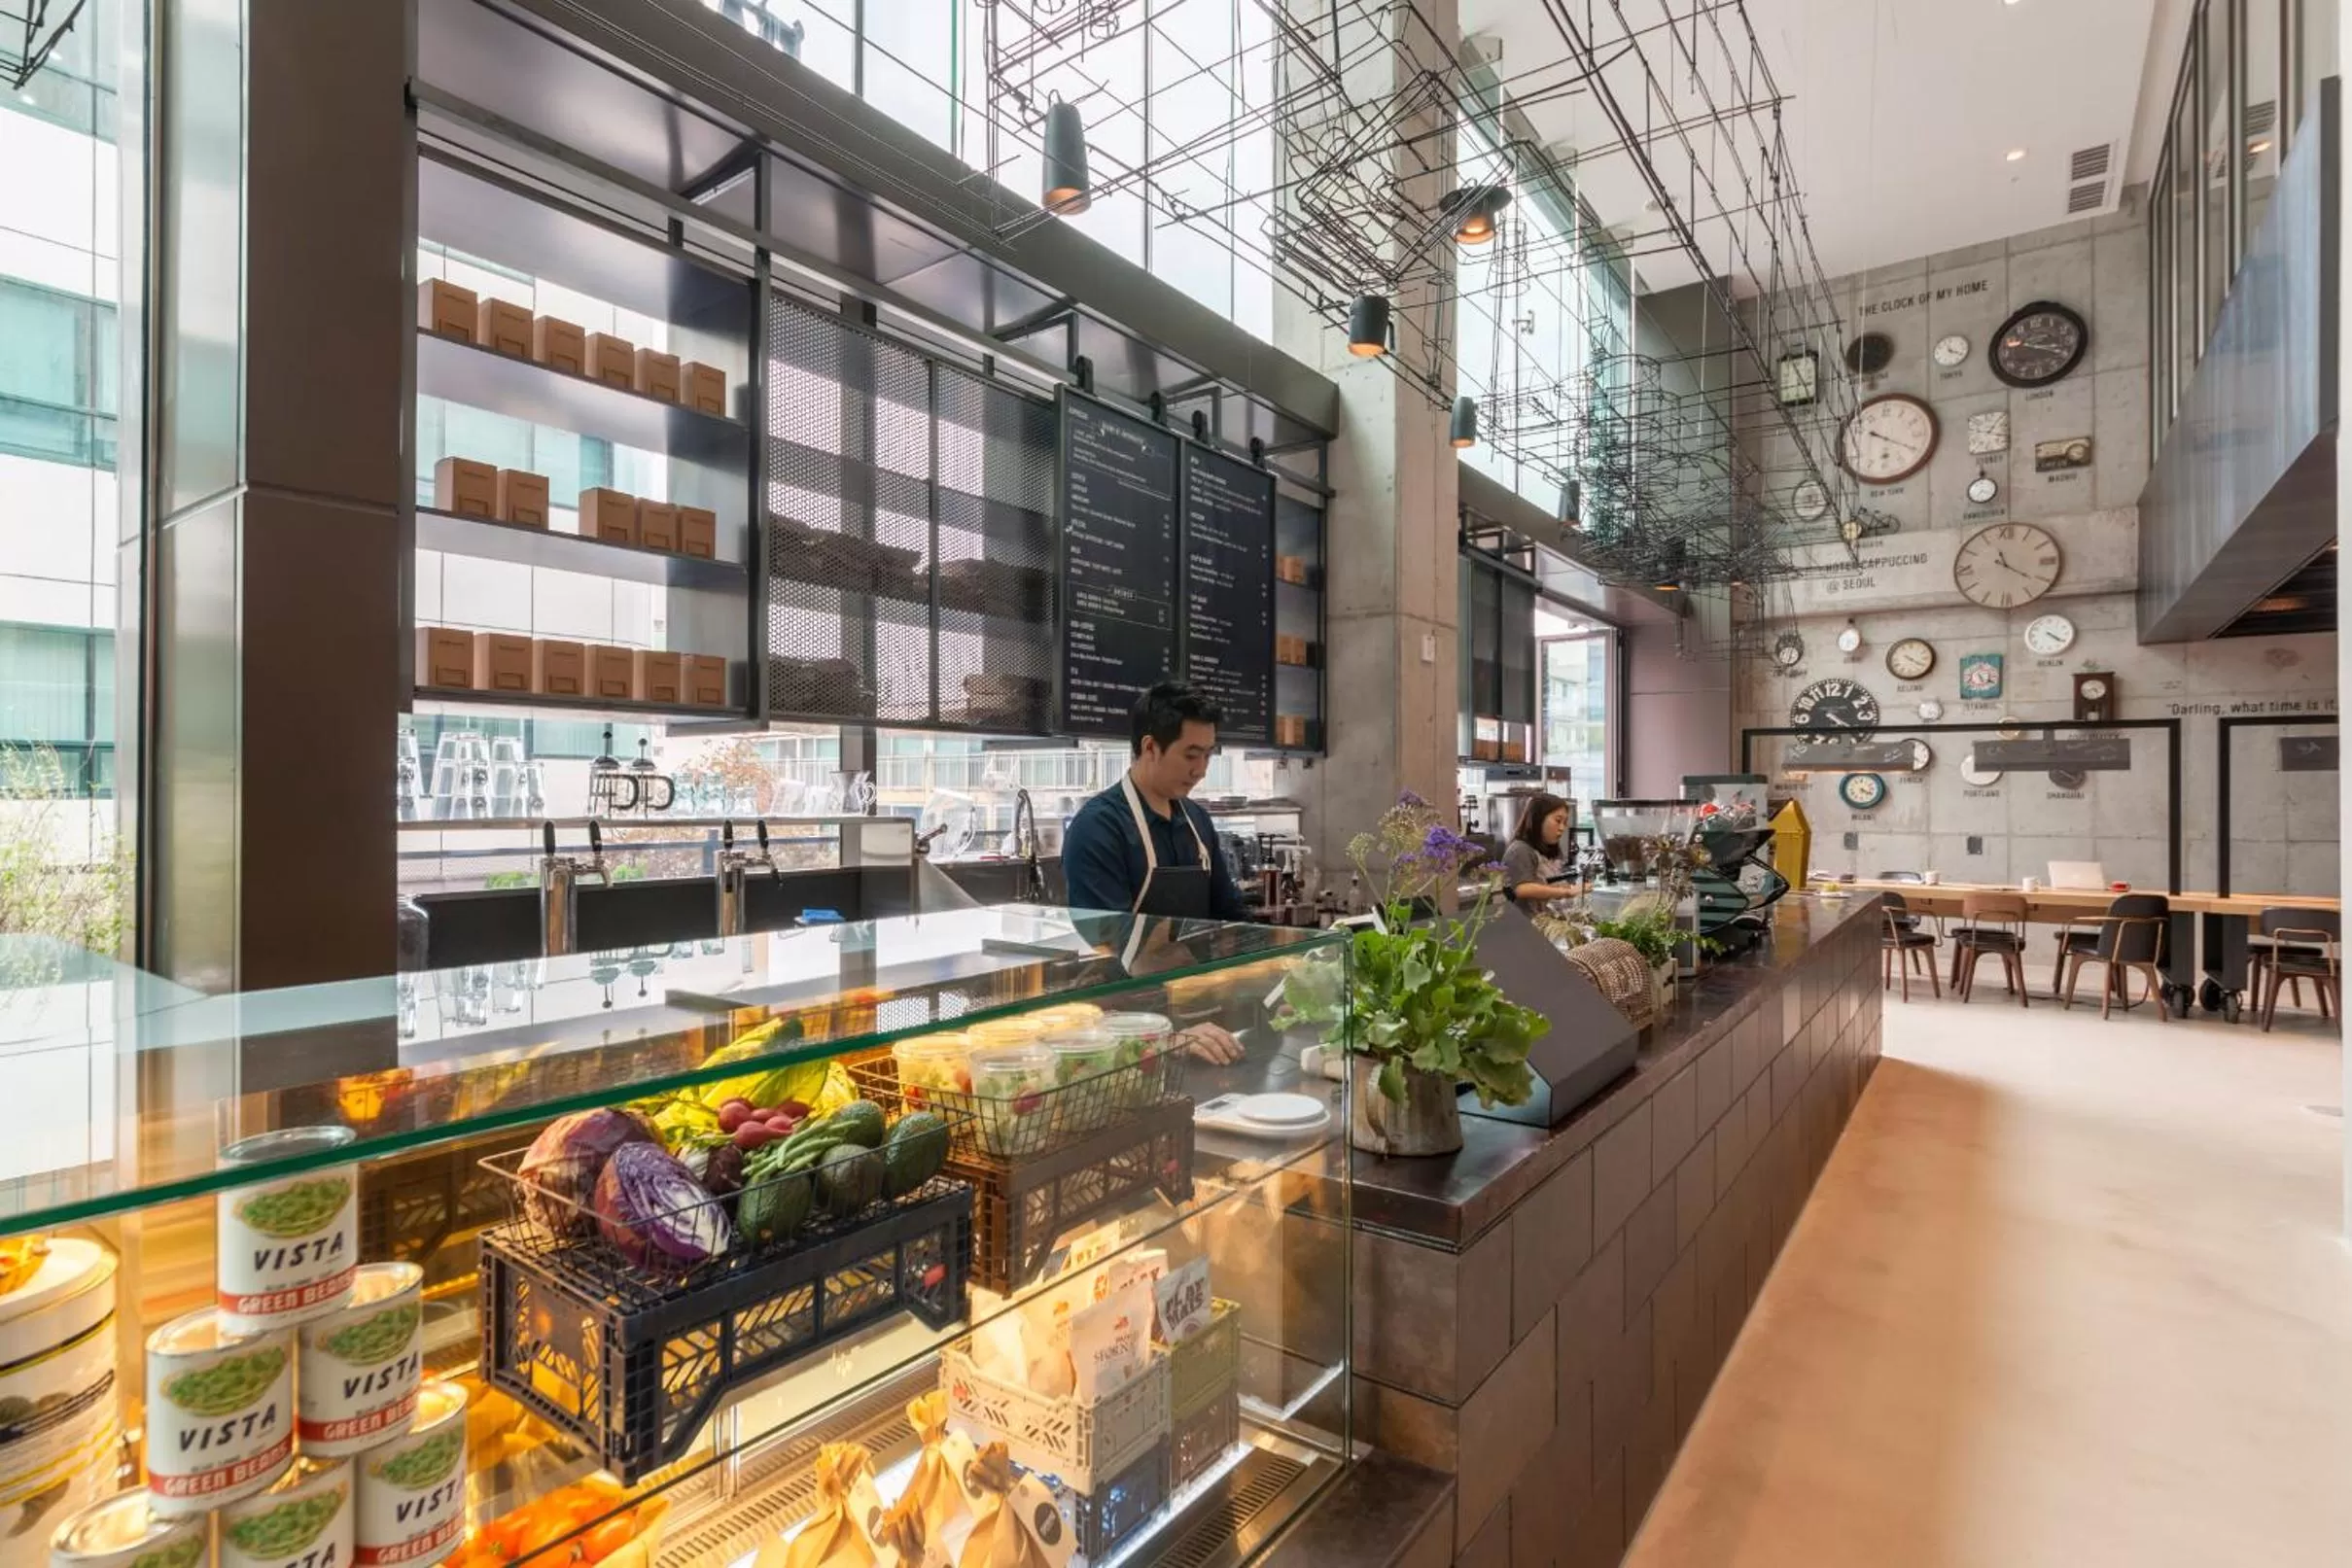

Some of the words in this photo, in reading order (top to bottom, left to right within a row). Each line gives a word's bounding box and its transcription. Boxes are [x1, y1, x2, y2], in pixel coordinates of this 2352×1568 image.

[1858, 303, 1878, 317] THE
[1880, 296, 1915, 313] CLOCK
[1918, 292, 1932, 305] OF
[1936, 288, 1953, 302] MY
[1956, 279, 1989, 297] HOME
[1859, 552, 1928, 570] CAPPUCCINO
[1843, 576, 1876, 590] SEOUL
[1808, 685, 1825, 702] 11
[1824, 682, 1842, 697] 12
[1851, 695, 1868, 709] 2
[2229, 701, 2264, 713] what
[2269, 701, 2302, 712] time
[254, 1231, 344, 1272] VISTA
[237, 1285, 298, 1313] GREEN
[302, 1269, 356, 1305] BEANS
[343, 1349, 419, 1399] VISTA
[179, 1402, 277, 1452] VISTA
[323, 1411, 382, 1440] GREEN
[163, 1469, 227, 1497] GREEN
[230, 1441, 289, 1487] BEANS
[376, 1534, 433, 1564] GREEN
